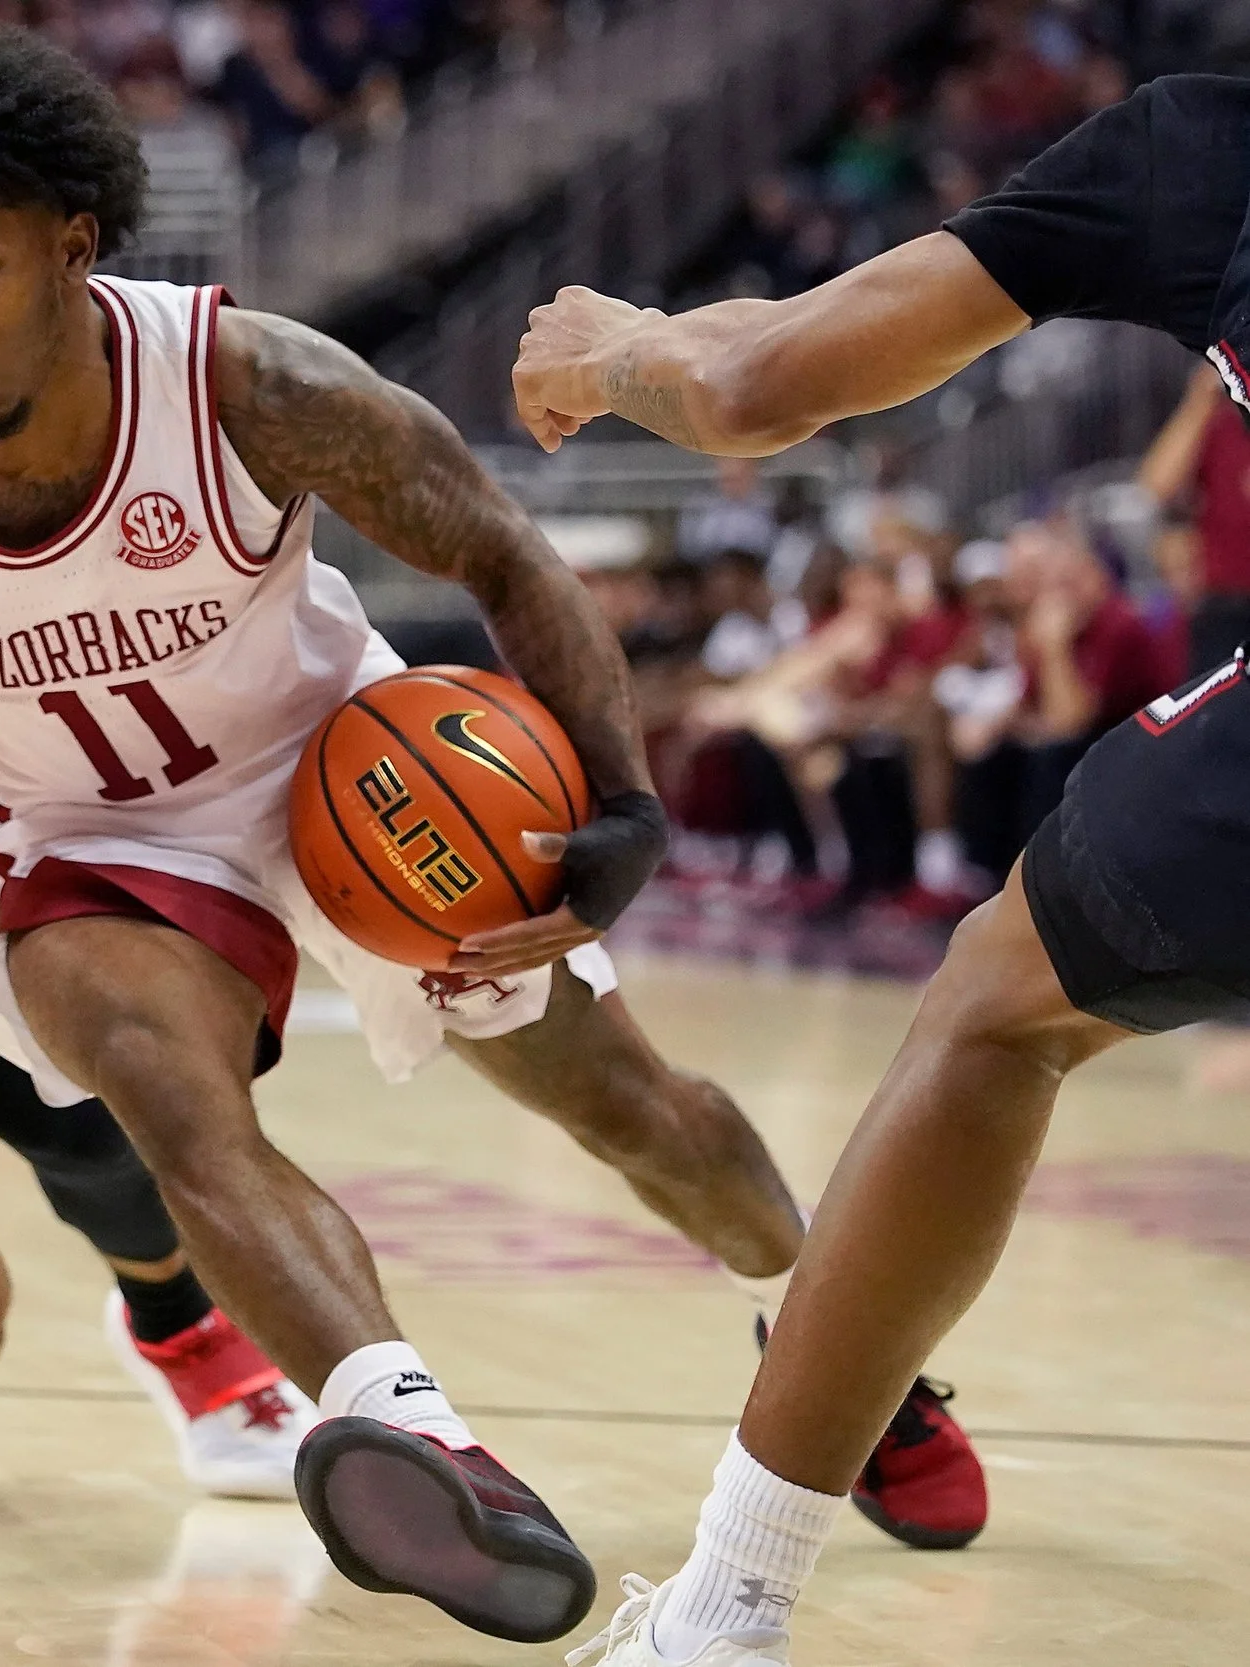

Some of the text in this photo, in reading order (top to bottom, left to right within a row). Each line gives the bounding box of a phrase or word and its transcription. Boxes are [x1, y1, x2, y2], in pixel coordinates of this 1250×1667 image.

[126, 495, 182, 550] SEC
[38, 679, 219, 801] 11
[356, 755, 483, 906] ELITE
